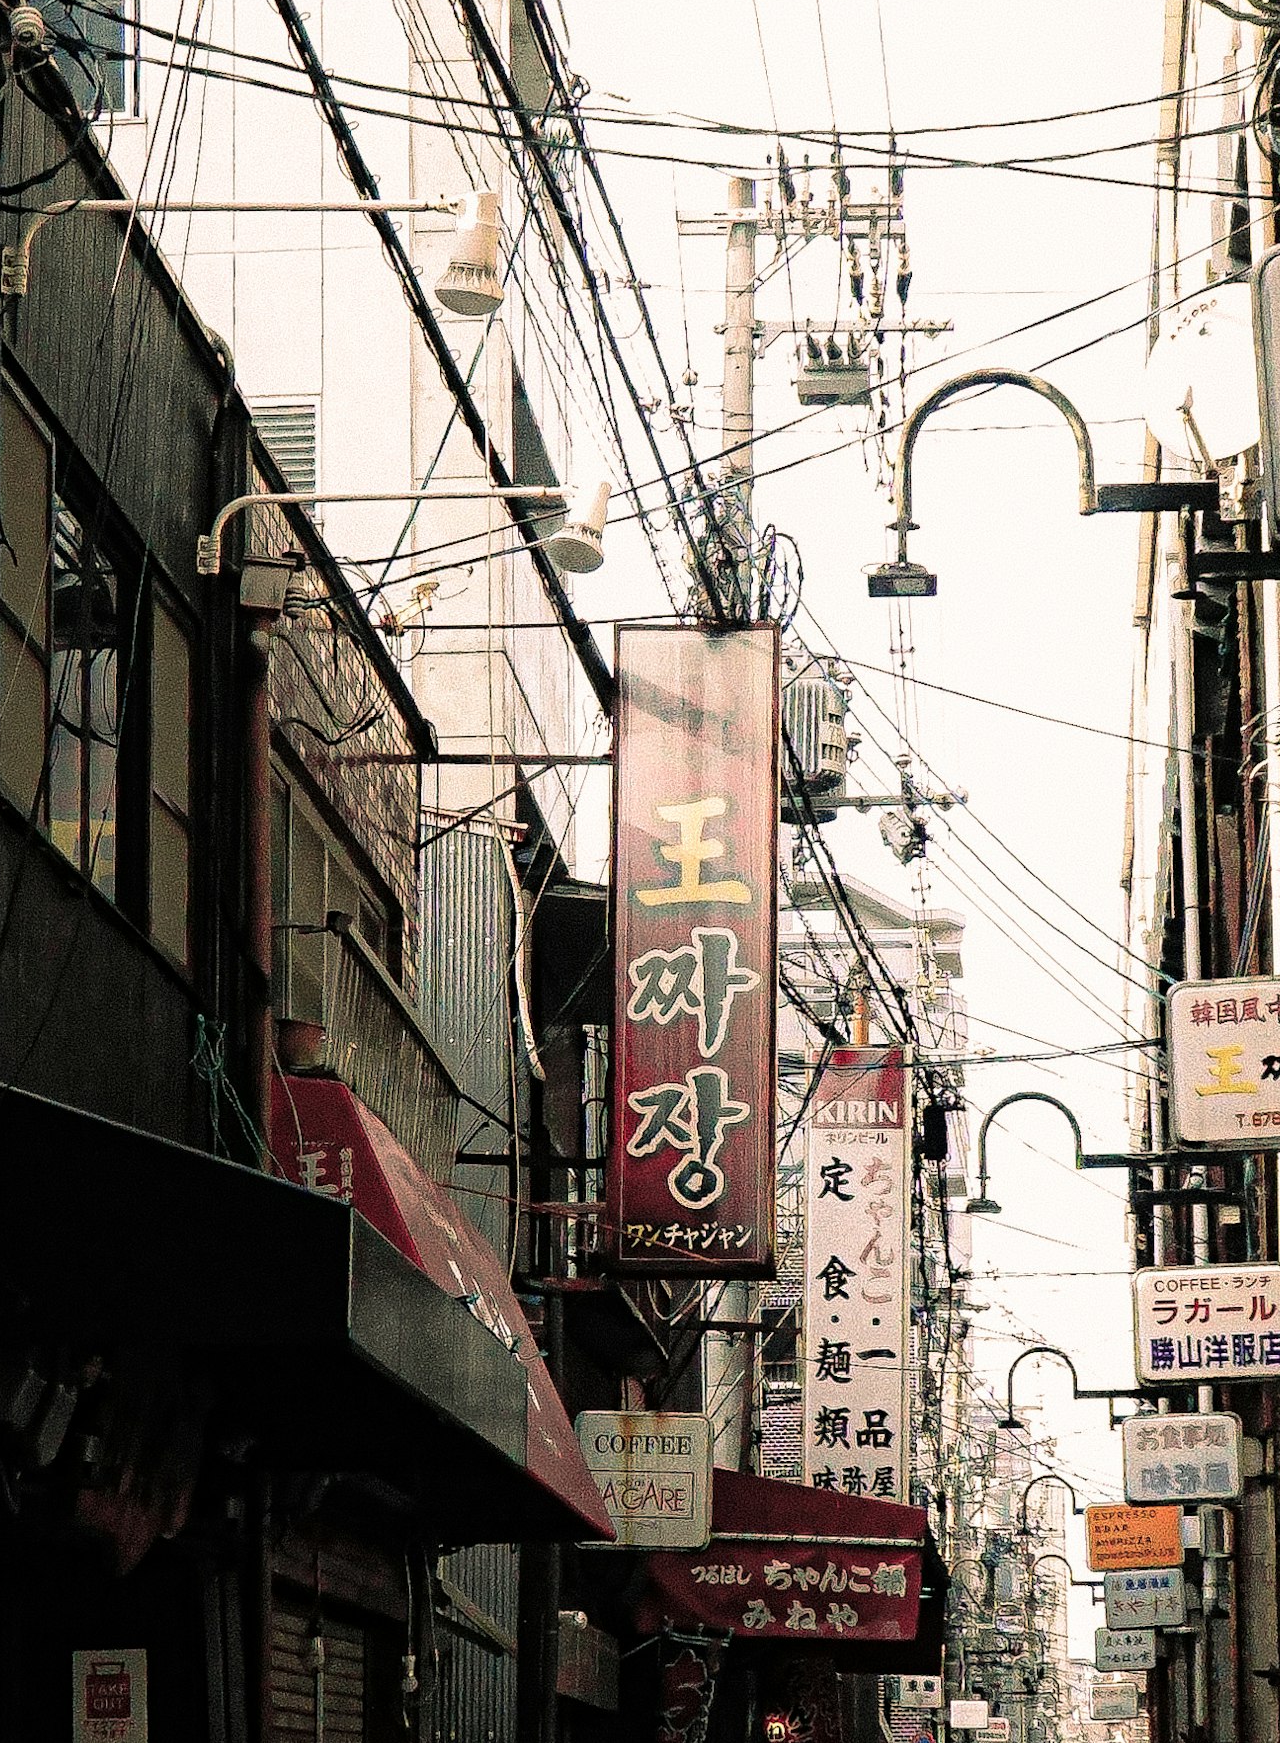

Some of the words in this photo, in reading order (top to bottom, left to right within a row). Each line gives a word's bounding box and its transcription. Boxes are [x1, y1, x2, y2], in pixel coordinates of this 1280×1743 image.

[816, 1099, 898, 1125] KIRIN
[626, 1221, 752, 1251] ワンチャジャン
[853, 1157, 899, 1450] ちゃんこ・一品
[1151, 1294, 1277, 1325] ラガール
[594, 1433, 693, 1456] COFFEE
[690, 1564, 753, 1586] つるはし
[763, 1559, 907, 1598] ちゃんこ鍋
[742, 1598, 859, 1633] みねや
